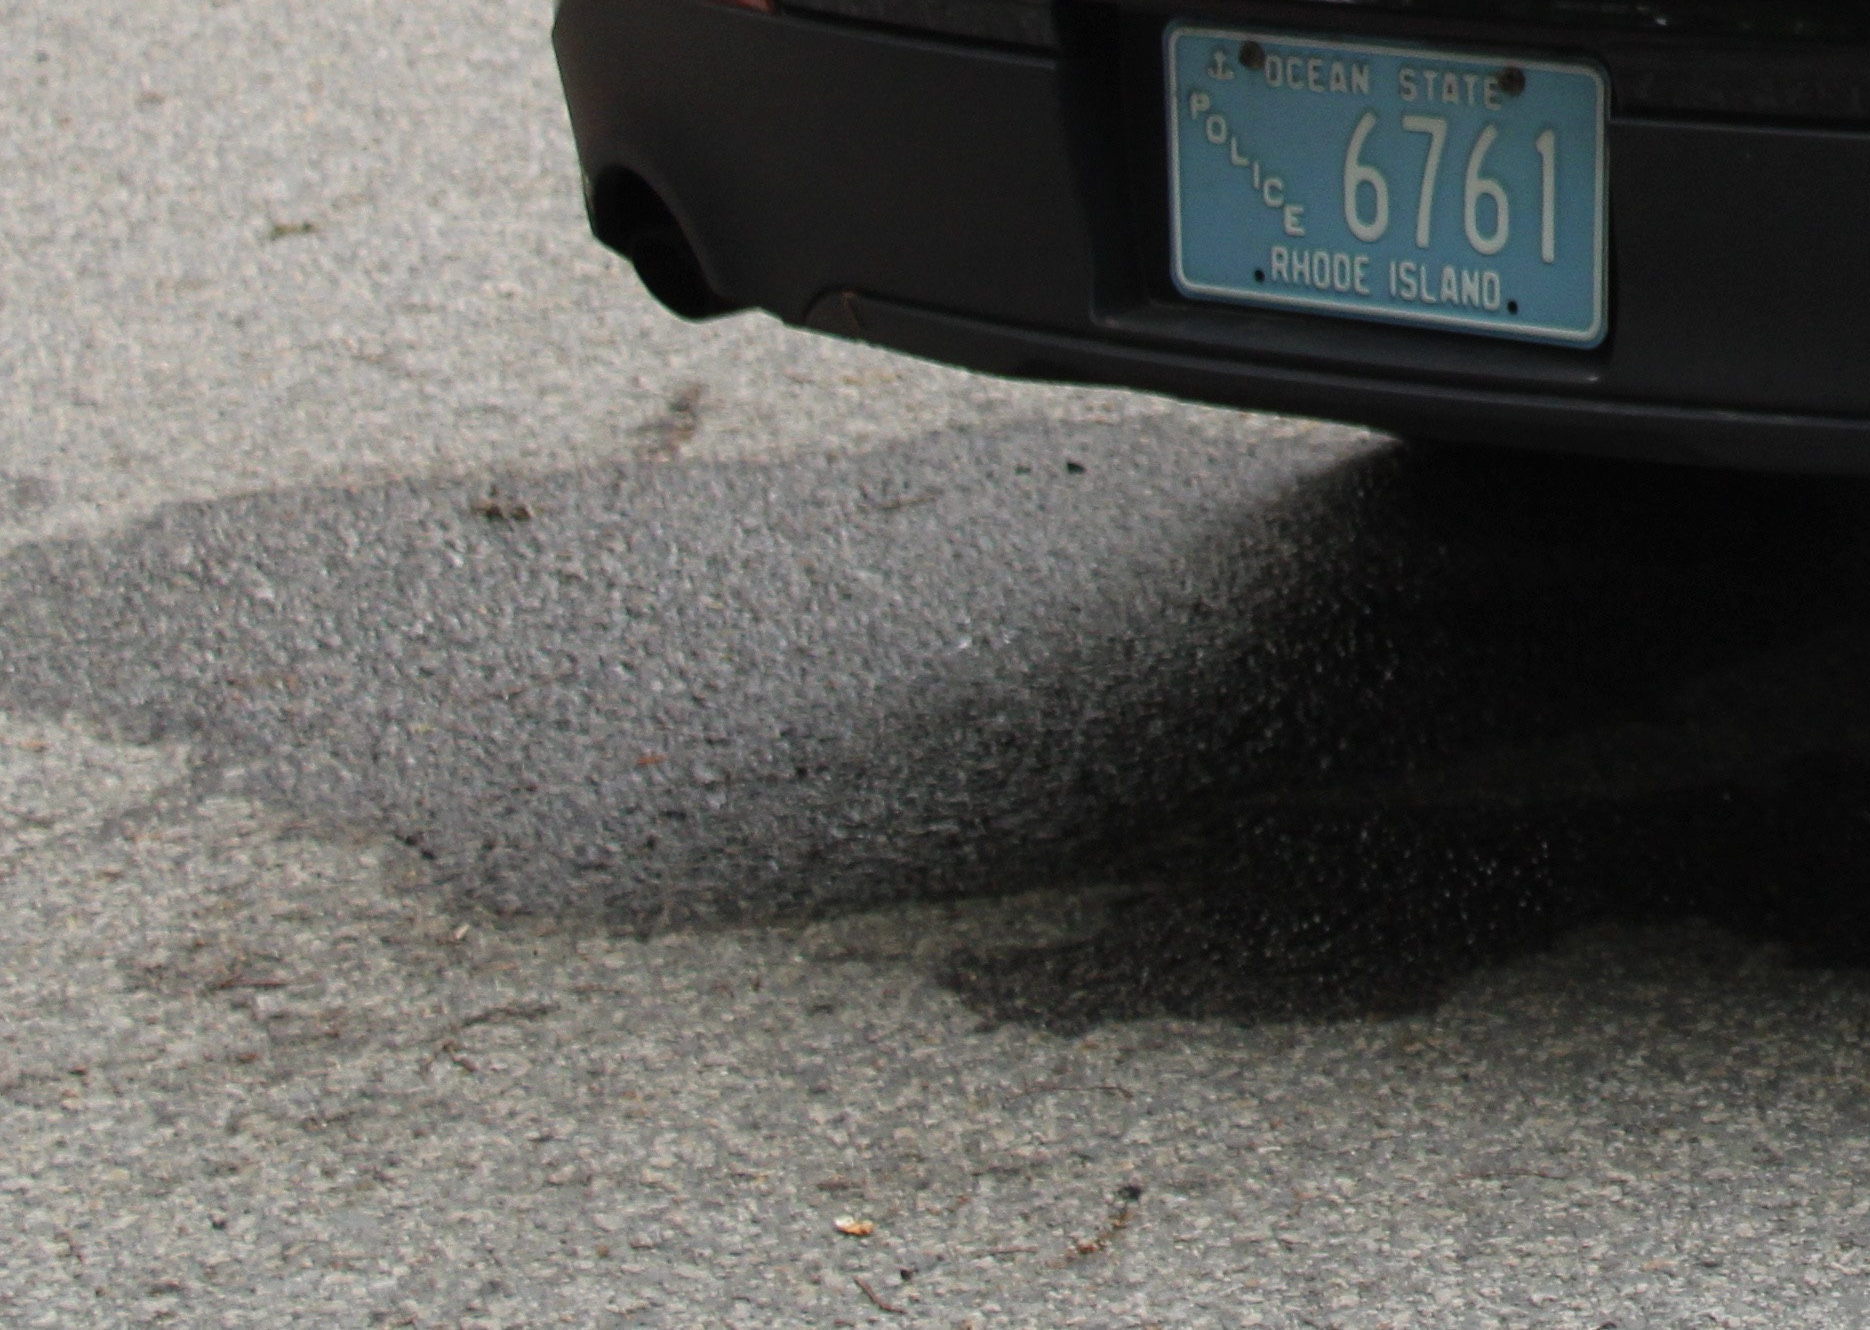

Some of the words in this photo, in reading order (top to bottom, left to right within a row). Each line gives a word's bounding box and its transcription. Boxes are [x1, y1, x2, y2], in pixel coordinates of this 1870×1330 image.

[1264, 54, 1370, 96] OCEAN
[1400, 67, 1502, 111] STATE
[1189, 91, 1305, 237] POLICE
[1343, 111, 1556, 265] 6761
[1270, 245, 1370, 296] RHODE
[1389, 260, 1502, 312] ISLAND
